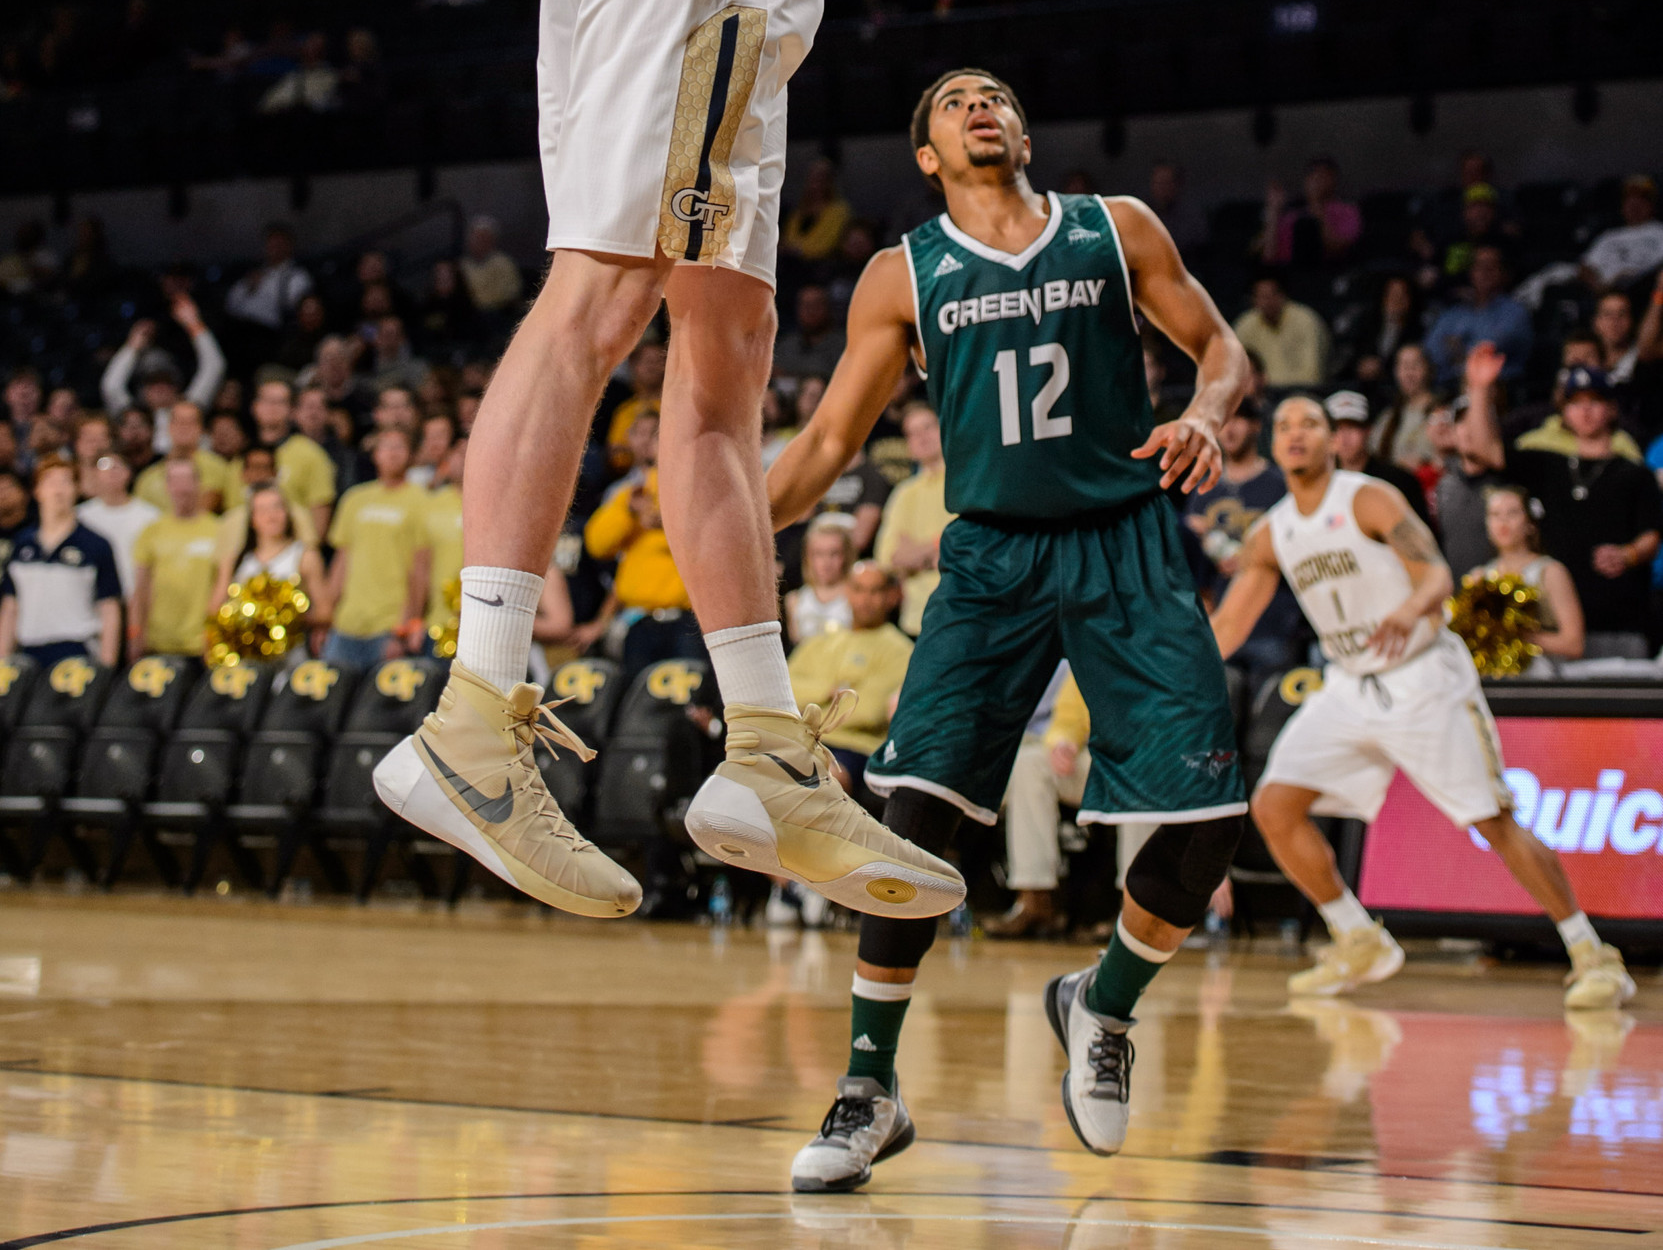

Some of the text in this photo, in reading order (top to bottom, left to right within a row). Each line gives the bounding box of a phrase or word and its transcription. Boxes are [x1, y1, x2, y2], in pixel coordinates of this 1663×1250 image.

[670, 187, 730, 231] GT
[937, 279, 1106, 335] GREEN BAY
[993, 342, 1073, 446] 12
[1330, 588, 1346, 625] 1
[1468, 768, 1663, 855] uic
